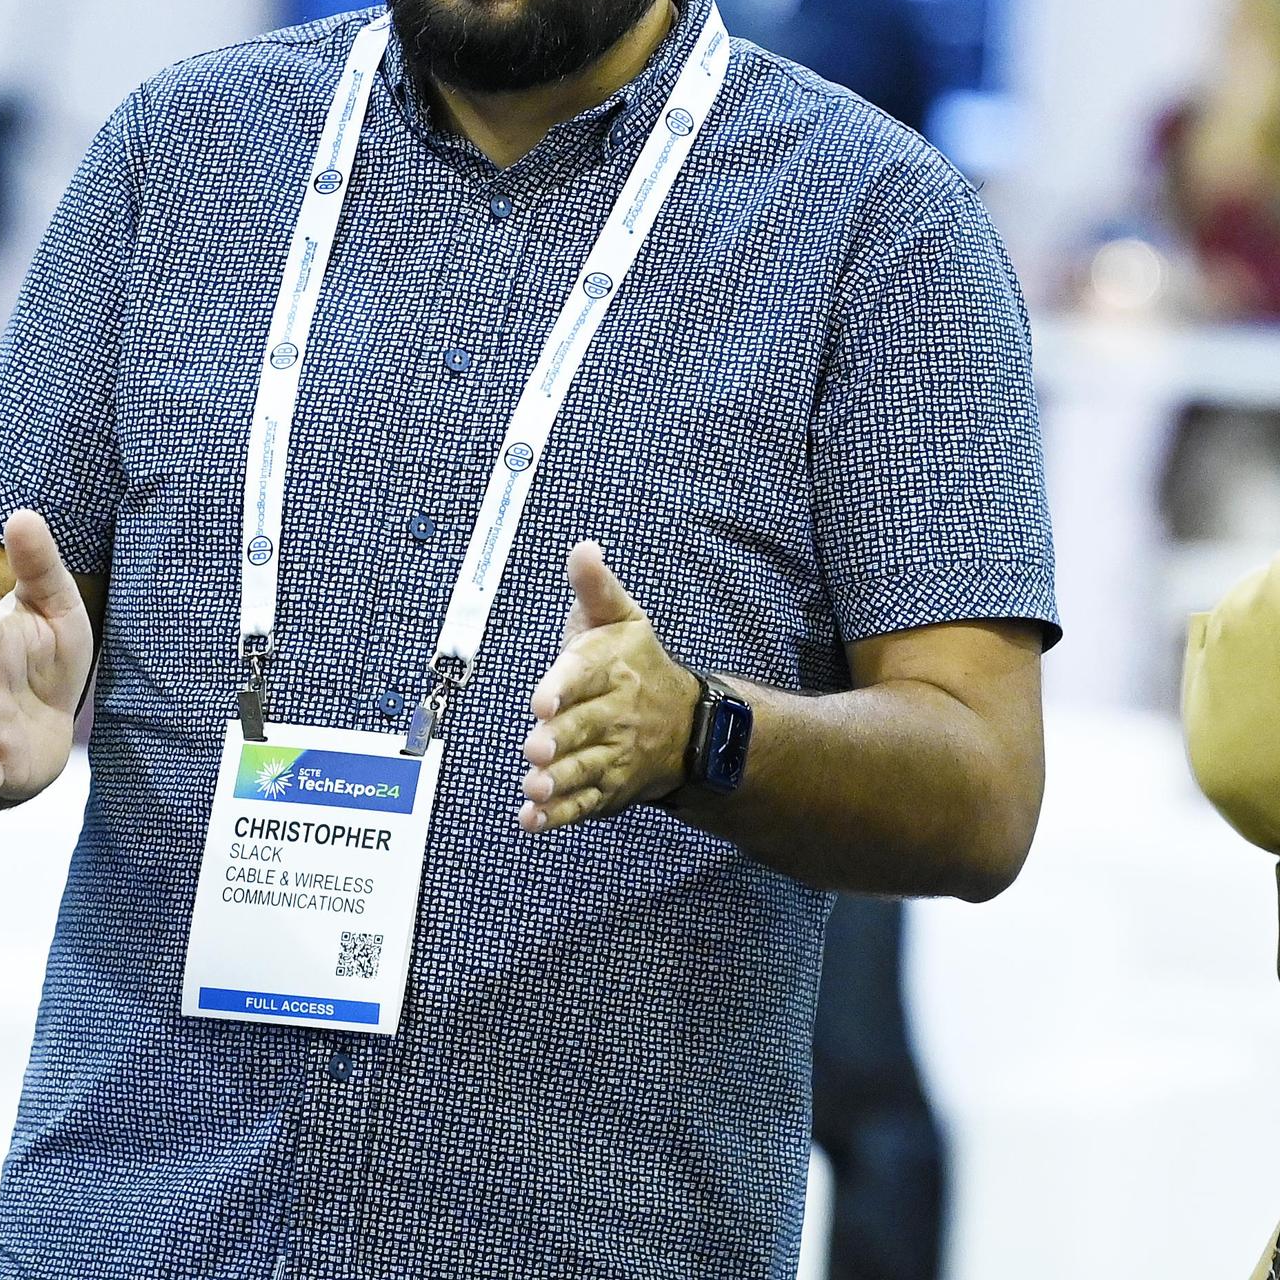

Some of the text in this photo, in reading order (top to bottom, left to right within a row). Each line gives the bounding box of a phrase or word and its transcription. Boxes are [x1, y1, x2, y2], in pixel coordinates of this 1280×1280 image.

[494, 471, 518, 526] BroadBand
[298, 767, 321, 777] SCTE
[297, 776, 400, 799] TechExpo24
[234, 816, 392, 852] CHRISTOPHER
[229, 843, 283, 863] SLACK
[225, 866, 374, 894] CABLE & WIRELESS
[222, 887, 366, 915] COMMUNICATIONS
[245, 996, 335, 1016] FULL ACCESS
